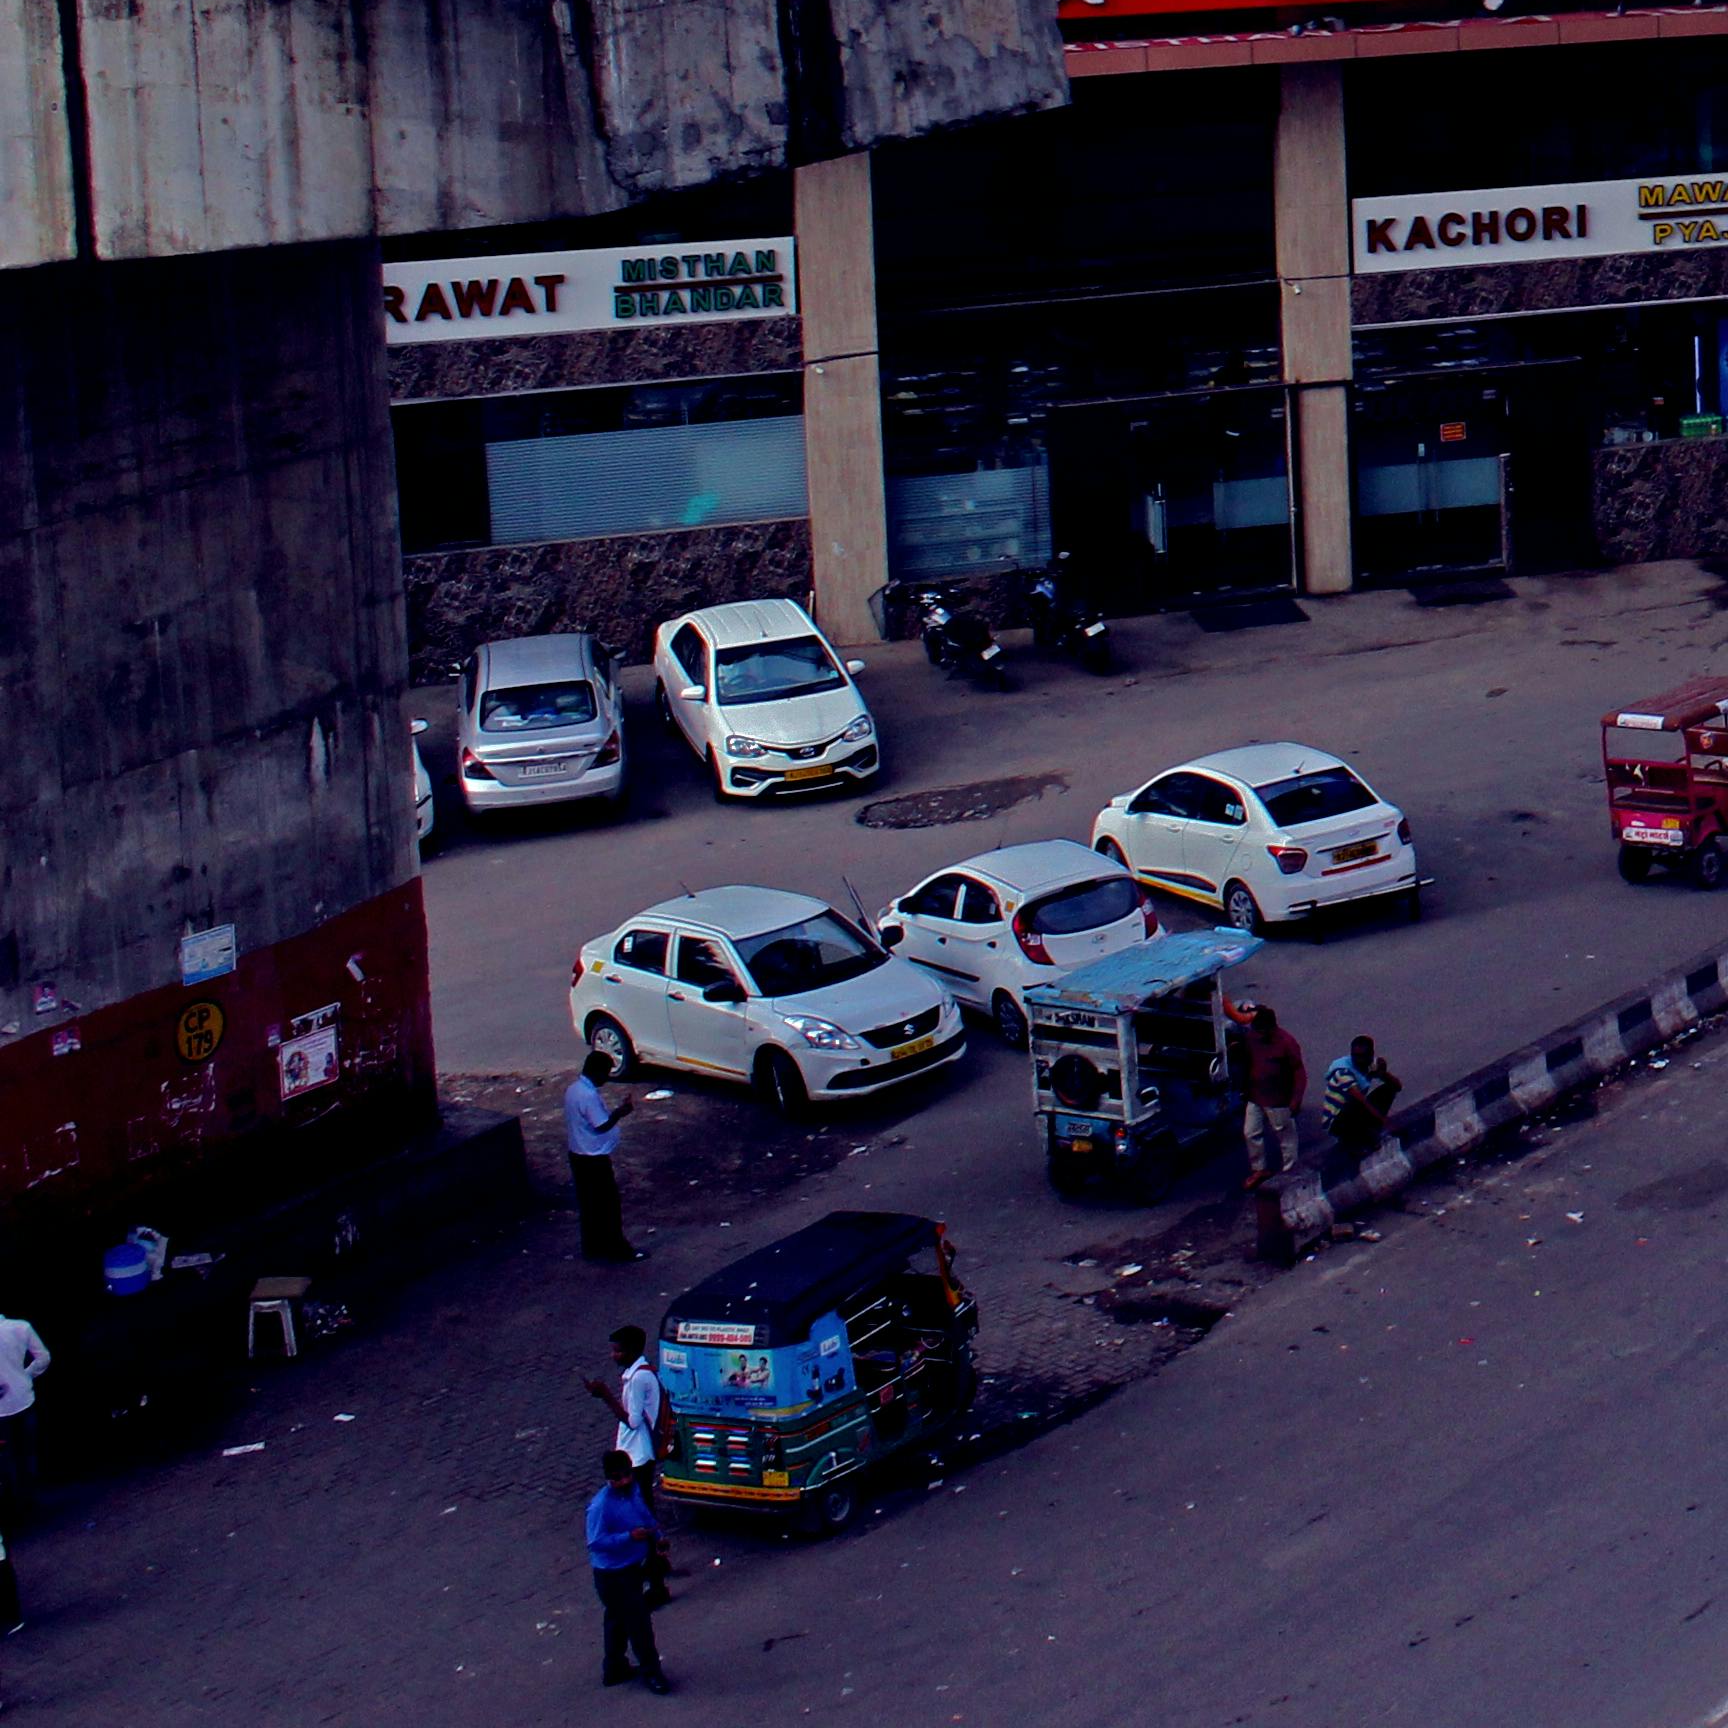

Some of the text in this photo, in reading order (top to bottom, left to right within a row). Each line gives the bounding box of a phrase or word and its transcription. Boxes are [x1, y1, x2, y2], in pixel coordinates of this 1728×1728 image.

[1367, 204, 1587, 254] KACHORI
[622, 250, 776, 283] MISTHAN
[383, 274, 565, 323] RAWAT
[614, 283, 784, 319] BHANDAR
[184, 1007, 211, 1034] CP
[186, 1029, 213, 1059] 179
